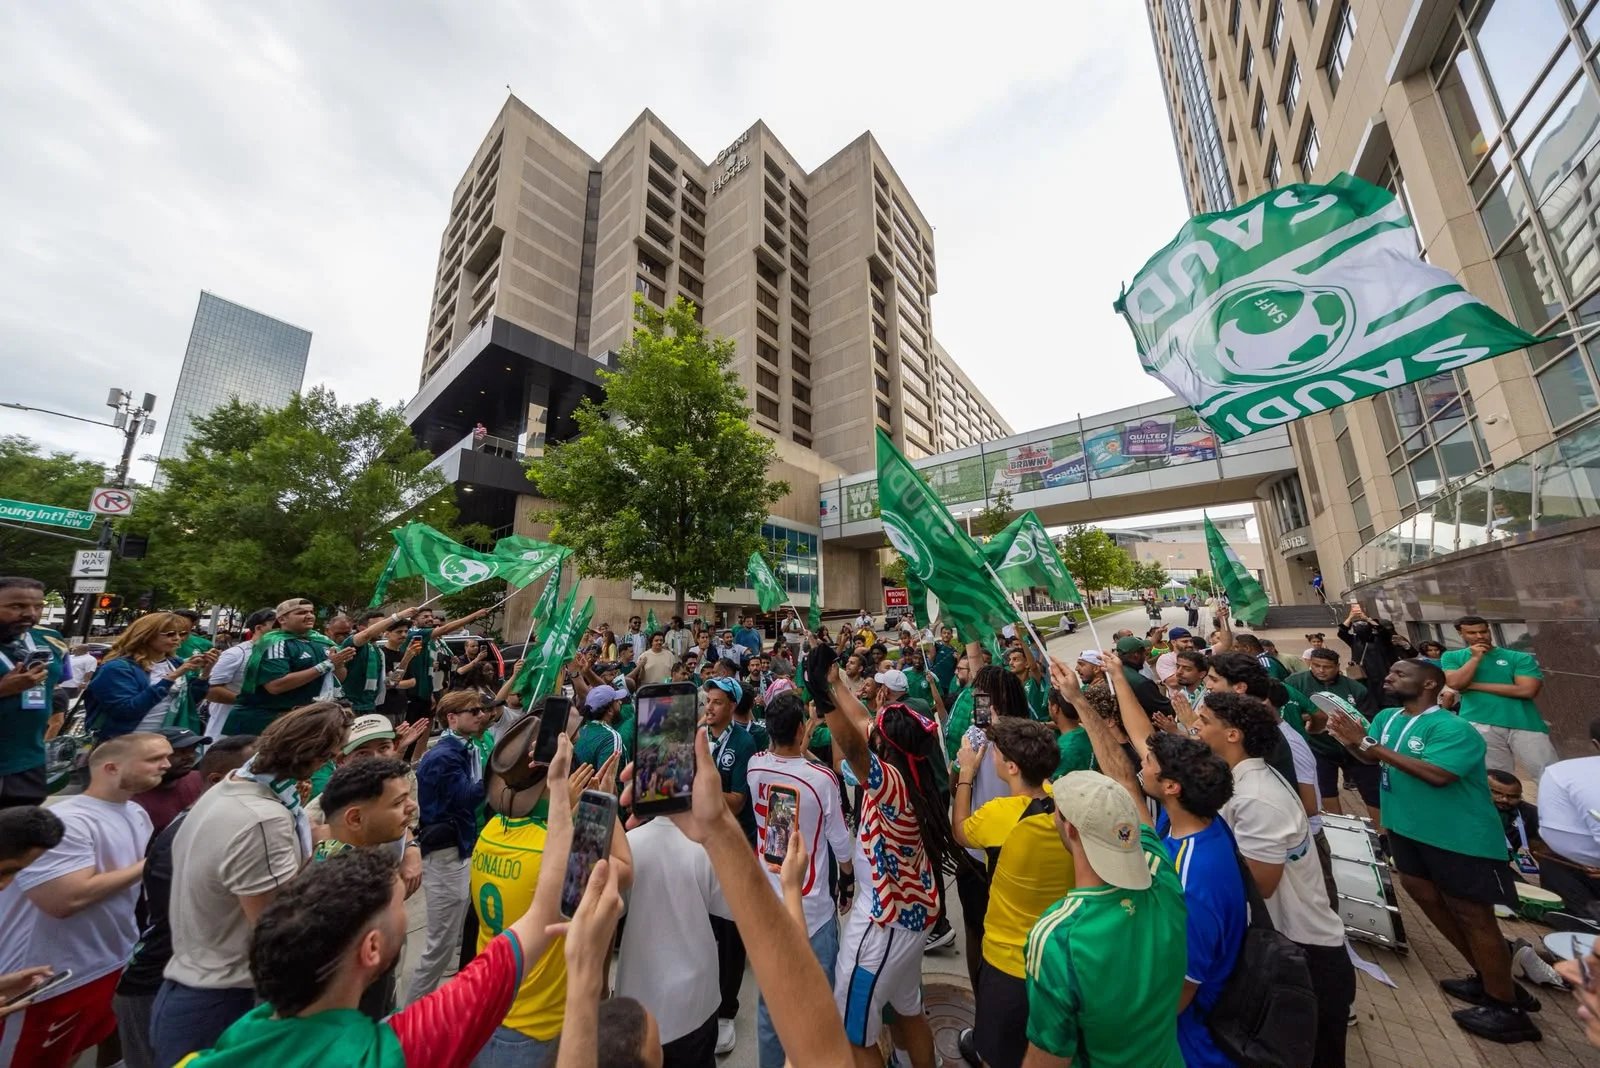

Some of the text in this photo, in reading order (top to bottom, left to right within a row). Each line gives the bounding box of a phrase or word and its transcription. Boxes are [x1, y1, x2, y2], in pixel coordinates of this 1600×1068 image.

[1126, 189, 1339, 326] SAUD
[1253, 297, 1288, 324] SAFF
[1225, 333, 1490, 435] SAUDI
[1129, 432, 1168, 440] QUILTED
[1010, 456, 1049, 470] BRAWNY
[0, 503, 36, 520] oung
[65, 511, 94, 521] Blvd
[849, 502, 873, 519] TO
[63, 518, 82, 527] NW
[472, 849, 522, 880] RONALDO
[479, 882, 504, 936] 9
